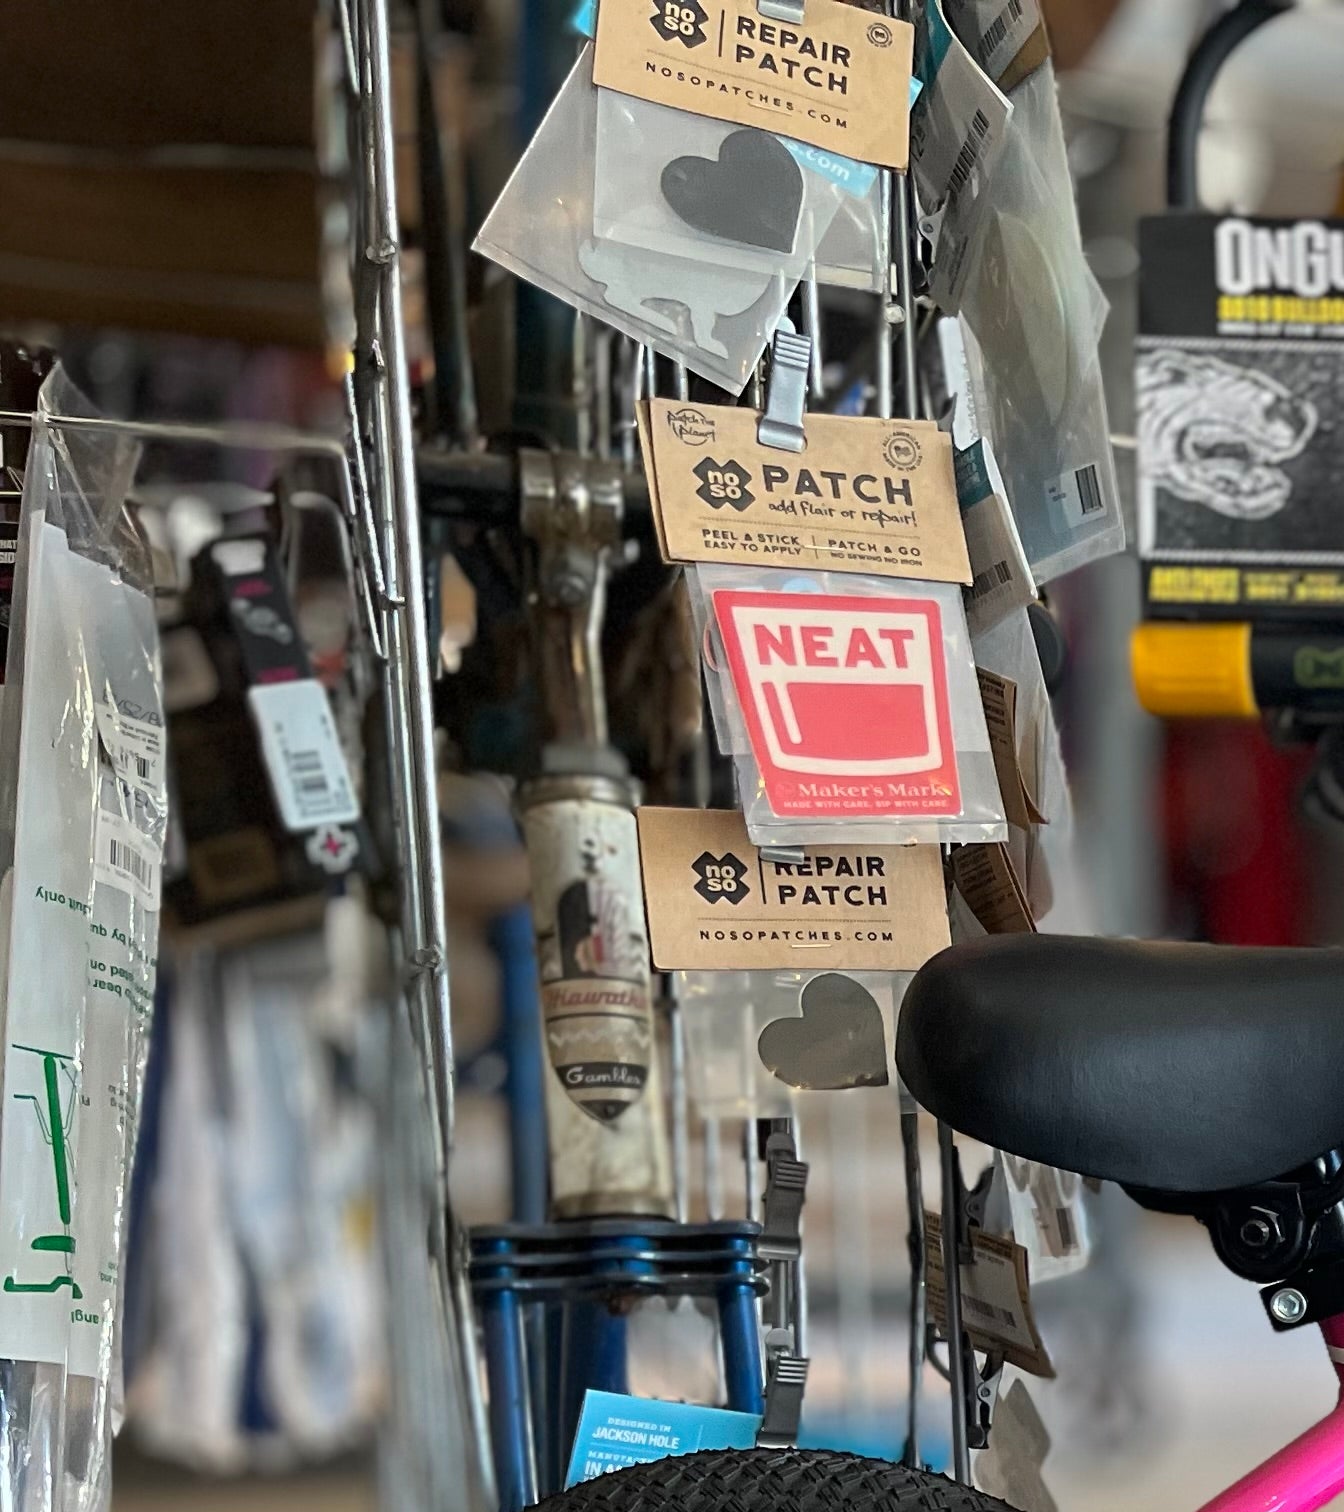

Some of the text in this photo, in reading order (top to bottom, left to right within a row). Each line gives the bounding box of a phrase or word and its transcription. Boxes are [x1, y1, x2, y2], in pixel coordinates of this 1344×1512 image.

[665, 2, 696, 23] no
[664, 16, 695, 36] so
[736, 15, 851, 68] REPAIR
[735, 44, 848, 95] PATCH
[645, 61, 848, 129] NOSOPATCHES.COM
[707, 470, 740, 487] no
[762, 464, 913, 507] PATCH
[709, 484, 742, 500] so
[768, 499, 918, 529] add flair or repair!
[702, 528, 738, 541] PEEL
[757, 532, 801, 546] STICK
[704, 540, 802, 556] EASY TO APPLY
[827, 539, 877, 553] PATCH
[898, 546, 921, 557] GO
[752, 623, 914, 669] NEAT
[799, 782, 885, 798] Maker's
[705, 864, 736, 880] no
[774, 856, 886, 877] REPAIR
[707, 878, 738, 893] so
[777, 884, 888, 906] PATCH
[699, 930, 894, 942] NOSOPATCHES.COM
[607, 1416, 657, 1432] DESIGNED
[592, 1426, 681, 1450] JACKSON HOLE
